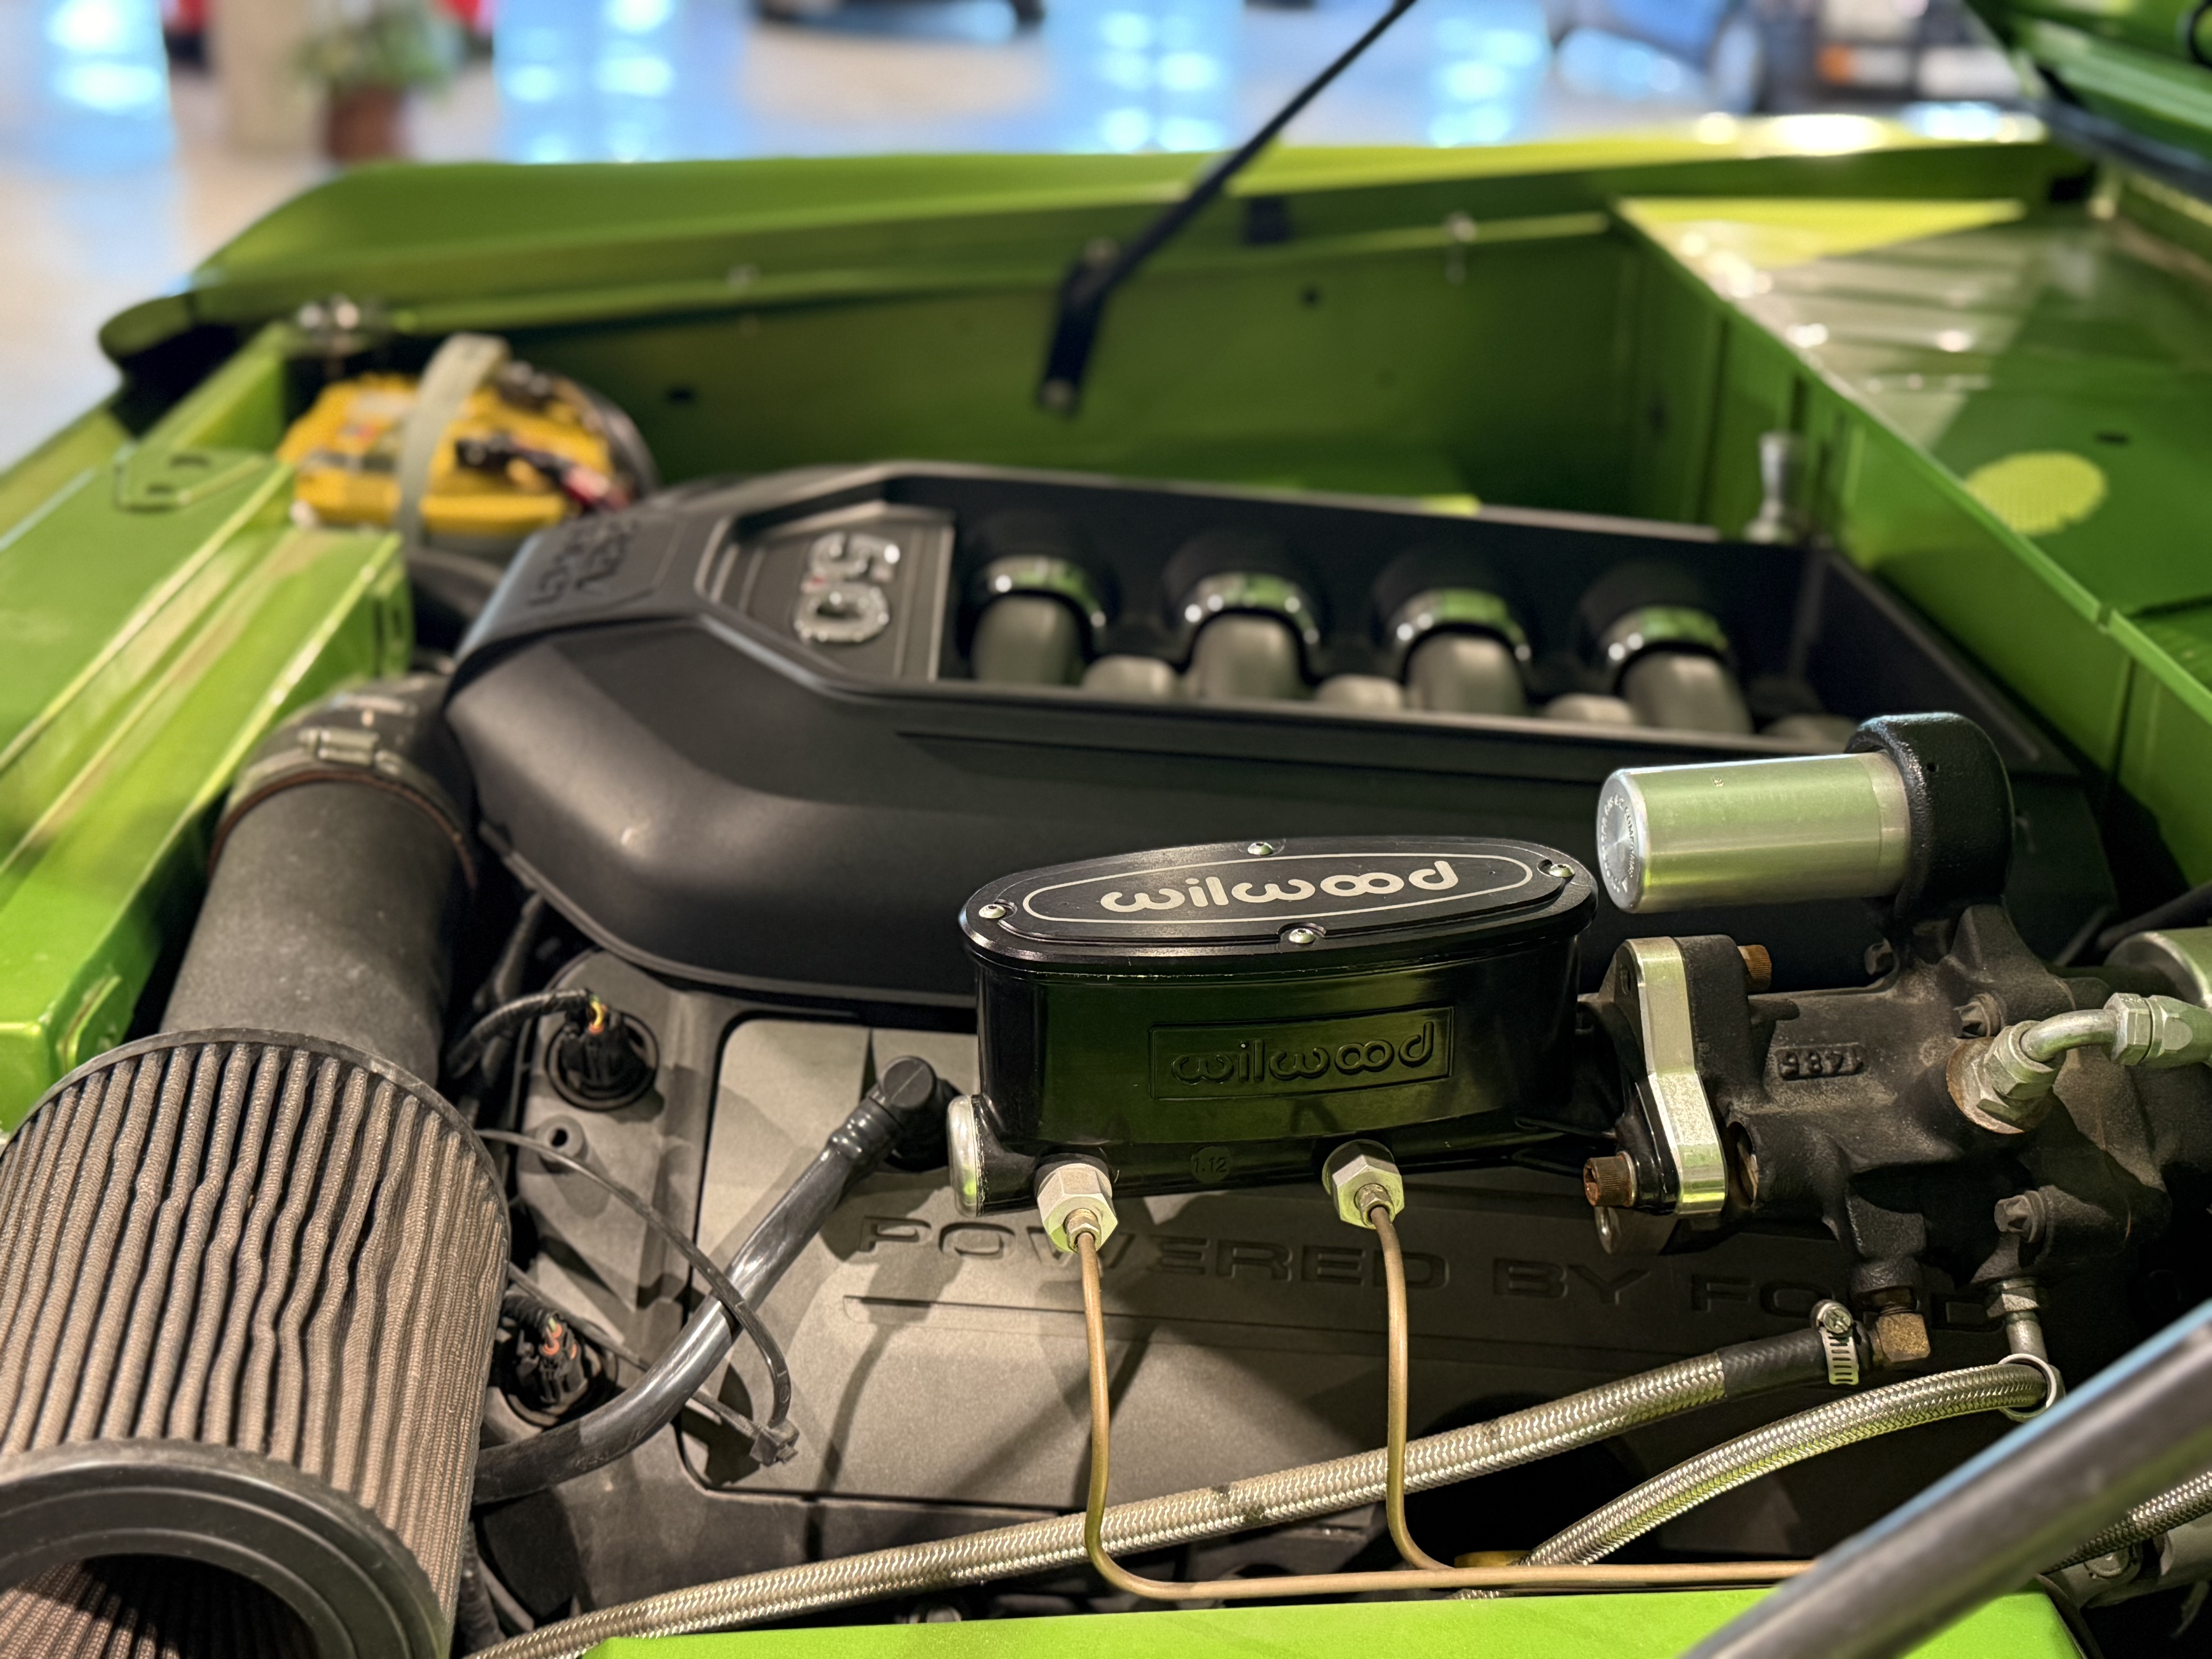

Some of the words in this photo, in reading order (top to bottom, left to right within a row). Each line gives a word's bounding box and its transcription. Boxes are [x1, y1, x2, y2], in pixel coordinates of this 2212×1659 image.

[1100, 860, 1459, 912] wilwood
[1171, 1021, 1434, 1084] wilwood
[1194, 1157, 1227, 1174] 1.12
[1493, 1257, 1651, 1306] BY
[1690, 1274, 2007, 1332] FOD
